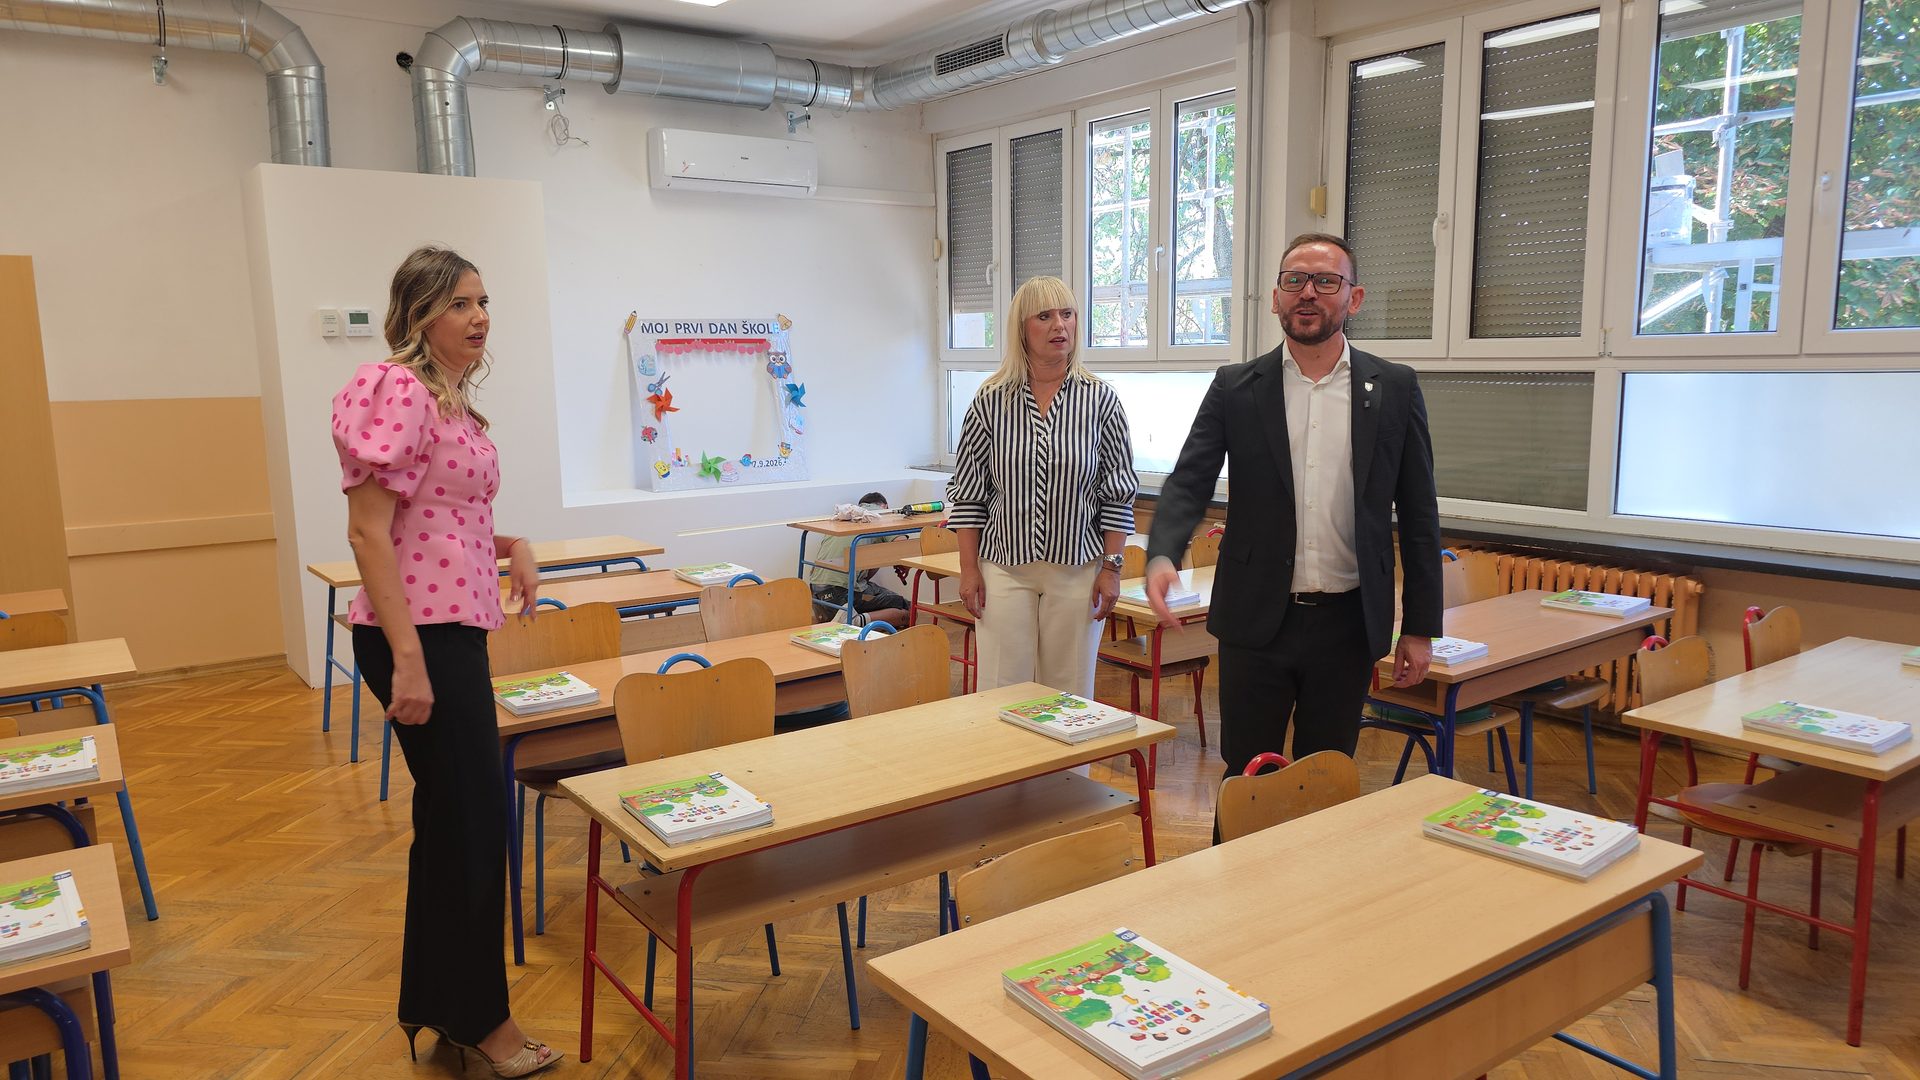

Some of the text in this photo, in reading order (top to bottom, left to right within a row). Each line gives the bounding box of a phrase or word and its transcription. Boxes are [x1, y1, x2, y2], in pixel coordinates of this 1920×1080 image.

[641, 322, 669, 334] MOJ
[675, 322, 704, 334] PRVI
[709, 322, 738, 334] DAN
